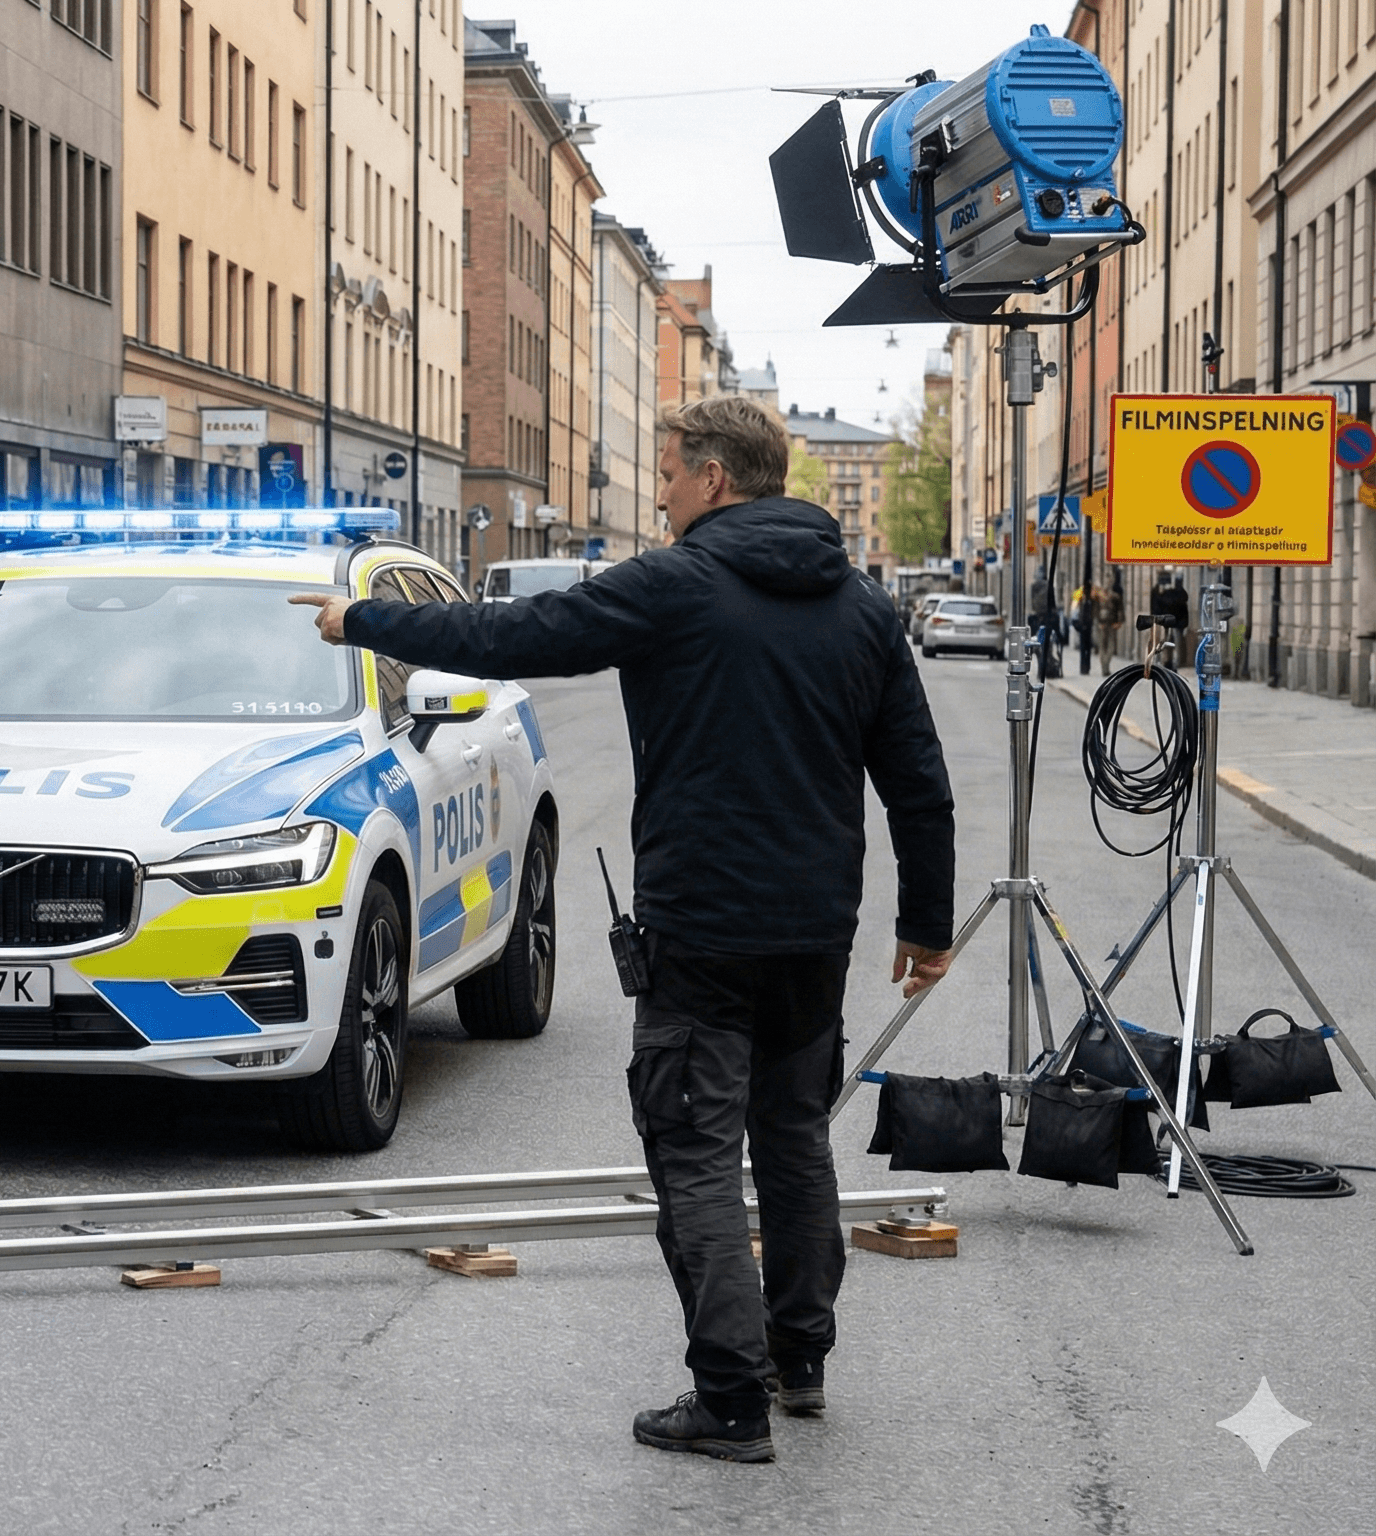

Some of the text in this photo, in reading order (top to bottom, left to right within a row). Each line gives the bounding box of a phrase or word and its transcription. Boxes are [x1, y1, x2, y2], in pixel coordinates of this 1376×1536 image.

[949, 201, 979, 235] ARRI
[1121, 410, 1325, 432] FILMINSPELNING
[432, 782, 485, 874] POLIS
